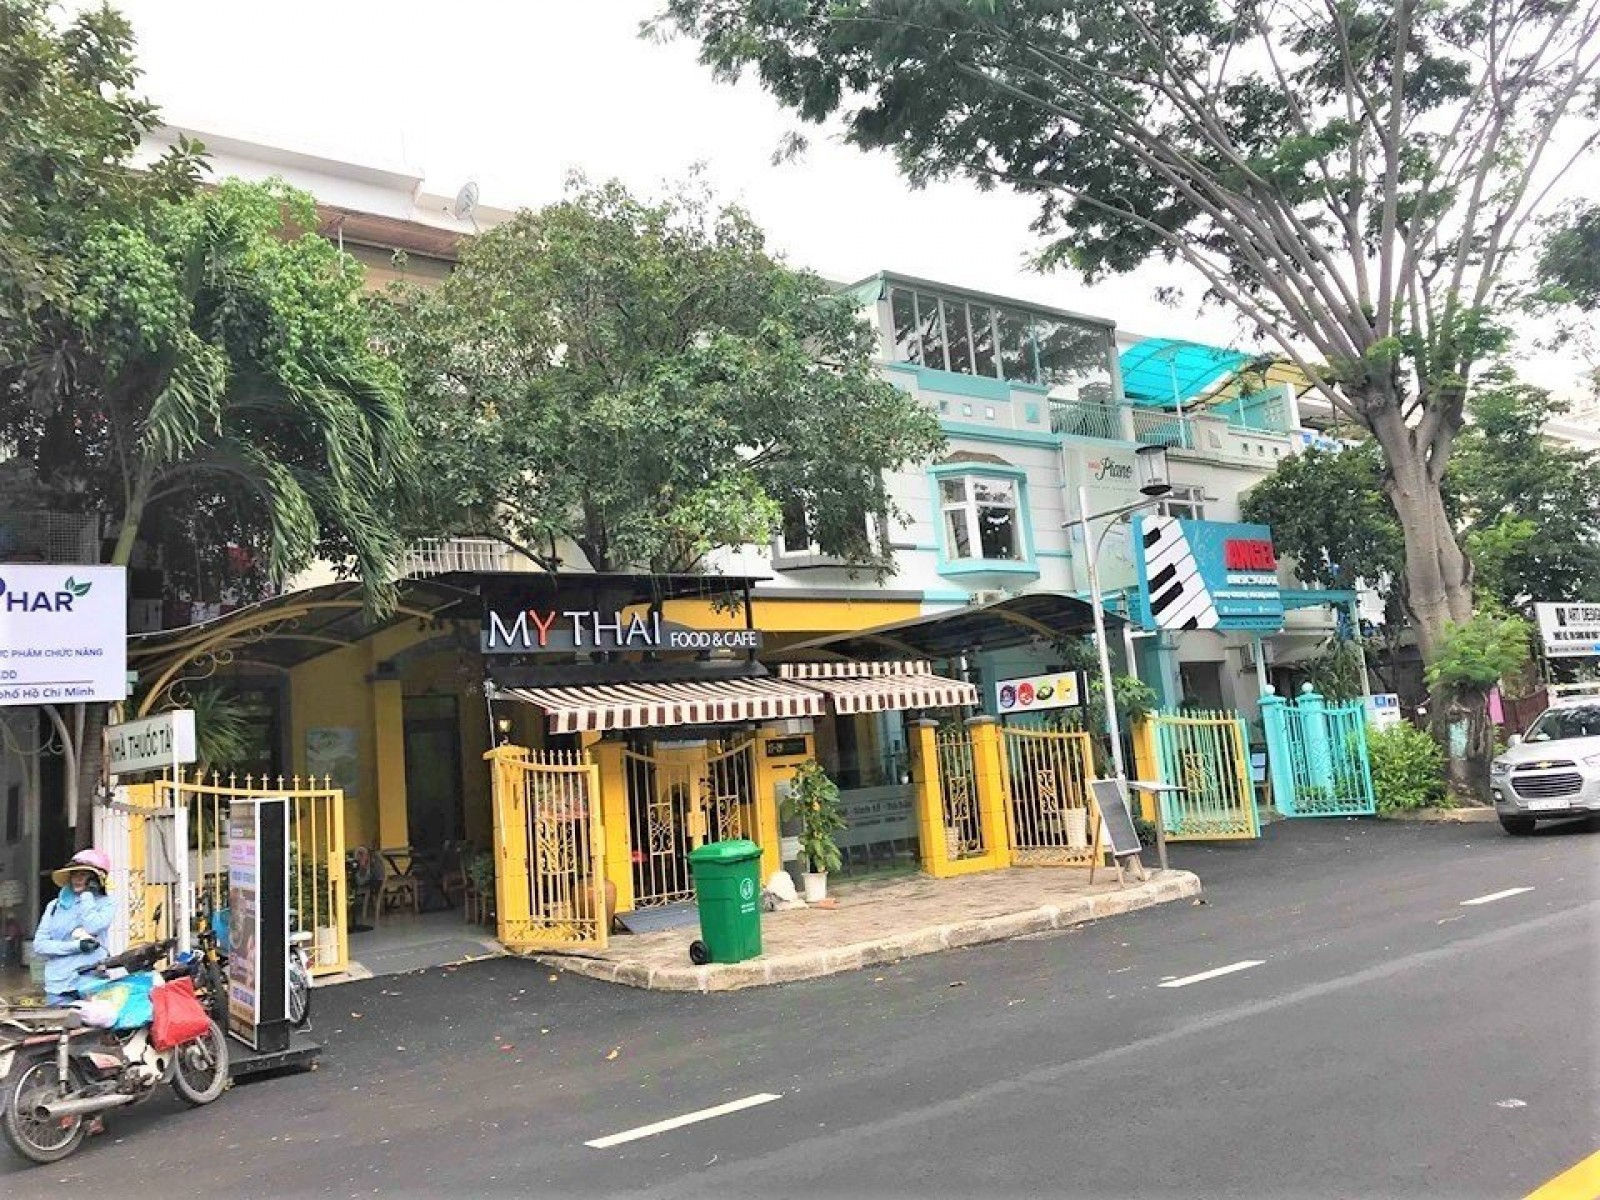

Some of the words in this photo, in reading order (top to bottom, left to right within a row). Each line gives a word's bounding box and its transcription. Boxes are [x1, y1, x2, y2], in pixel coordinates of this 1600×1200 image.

[488, 609, 555, 647] MY
[563, 610, 661, 647] THAI
[64, 685, 95, 697] Minh
[158, 722, 174, 754] TÂ
